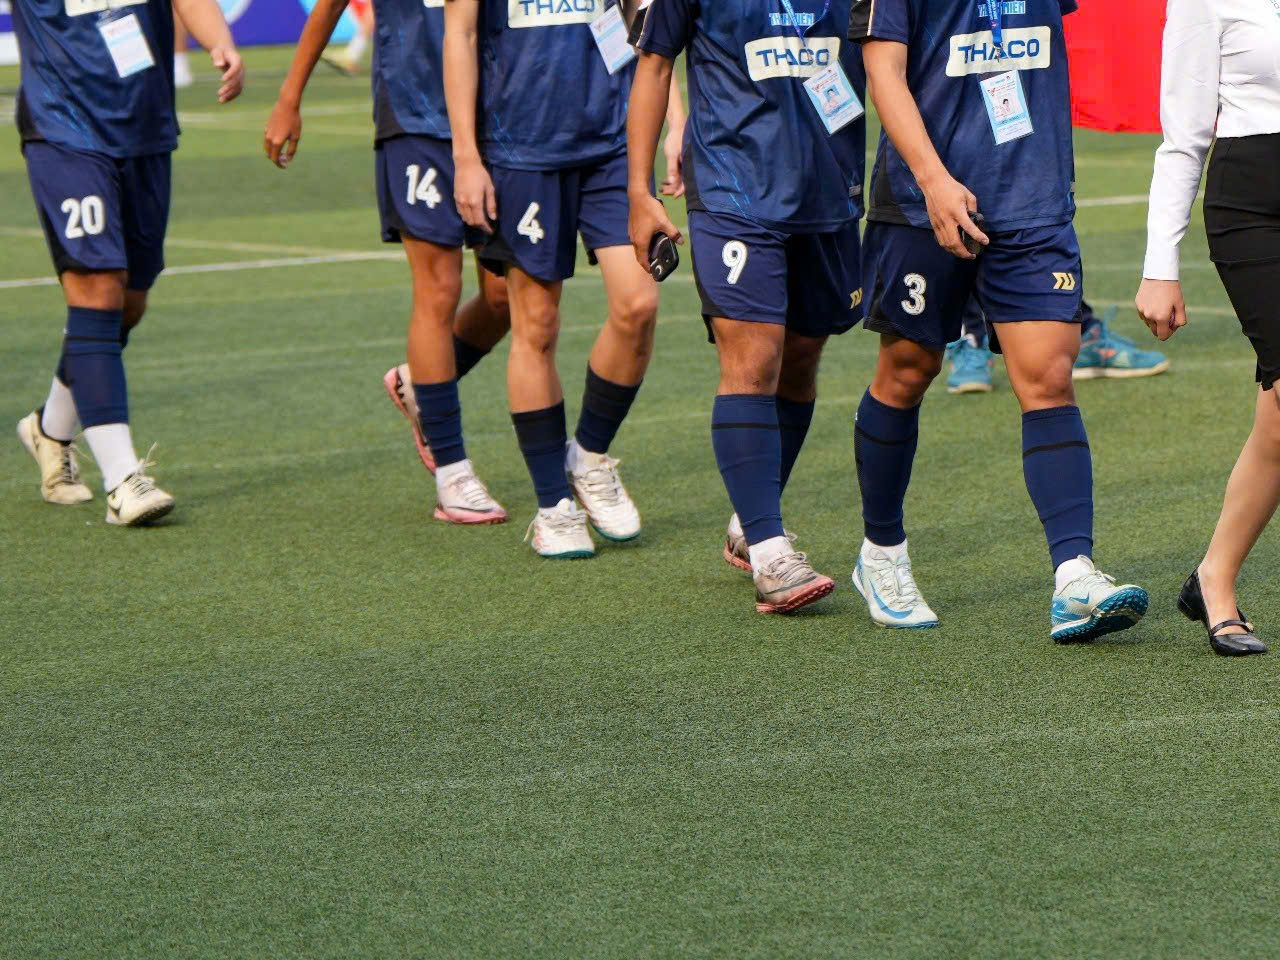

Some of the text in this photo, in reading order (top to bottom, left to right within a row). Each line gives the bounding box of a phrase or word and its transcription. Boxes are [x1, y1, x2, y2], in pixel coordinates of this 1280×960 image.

[756, 48, 830, 67] THACO
[958, 38, 1039, 64] THACO
[406, 164, 442, 209] 14
[61, 195, 105, 239] 20
[516, 201, 544, 244] 4
[721, 240, 748, 285] 9
[901, 273, 927, 316] 3
